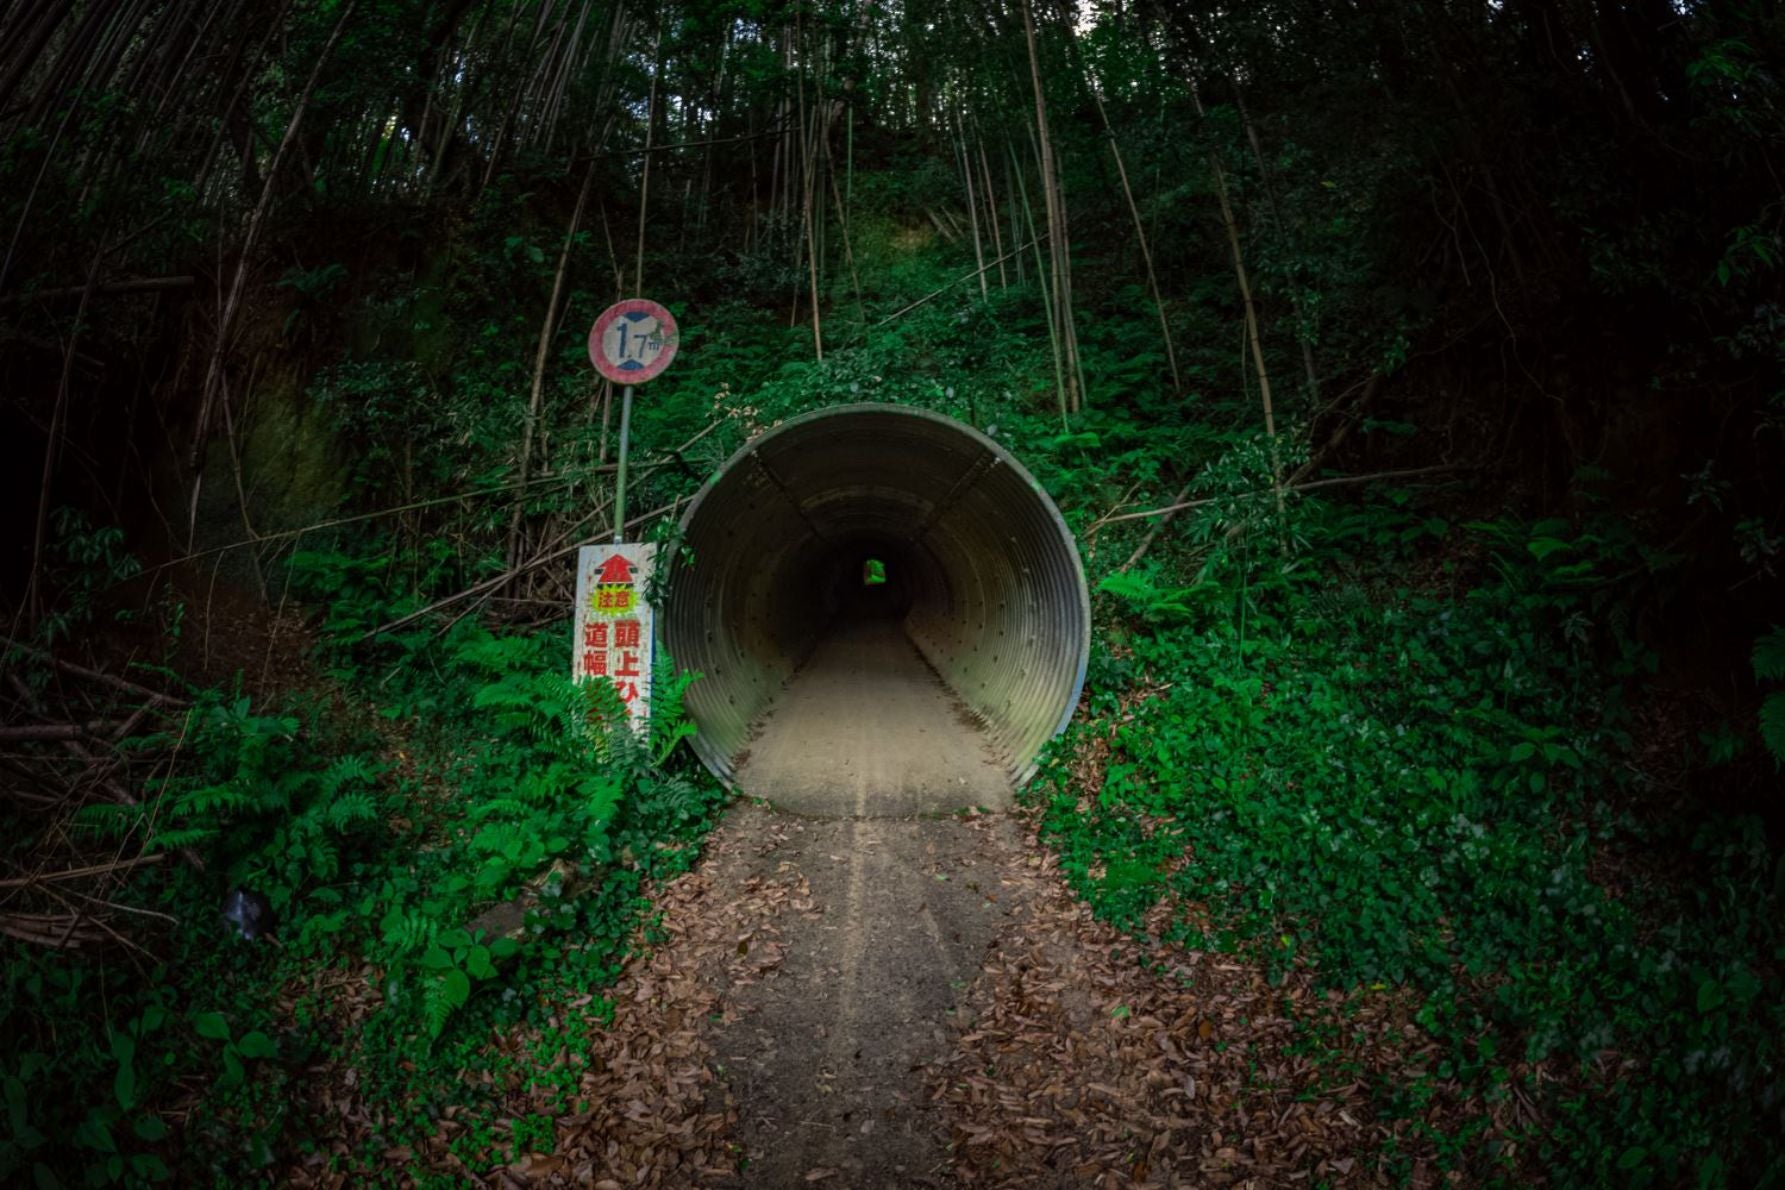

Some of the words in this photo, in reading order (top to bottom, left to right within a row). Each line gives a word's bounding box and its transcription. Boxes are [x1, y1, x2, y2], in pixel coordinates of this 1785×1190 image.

[598, 590, 630, 609] 注意
[614, 619, 641, 716] 頭上ひ
